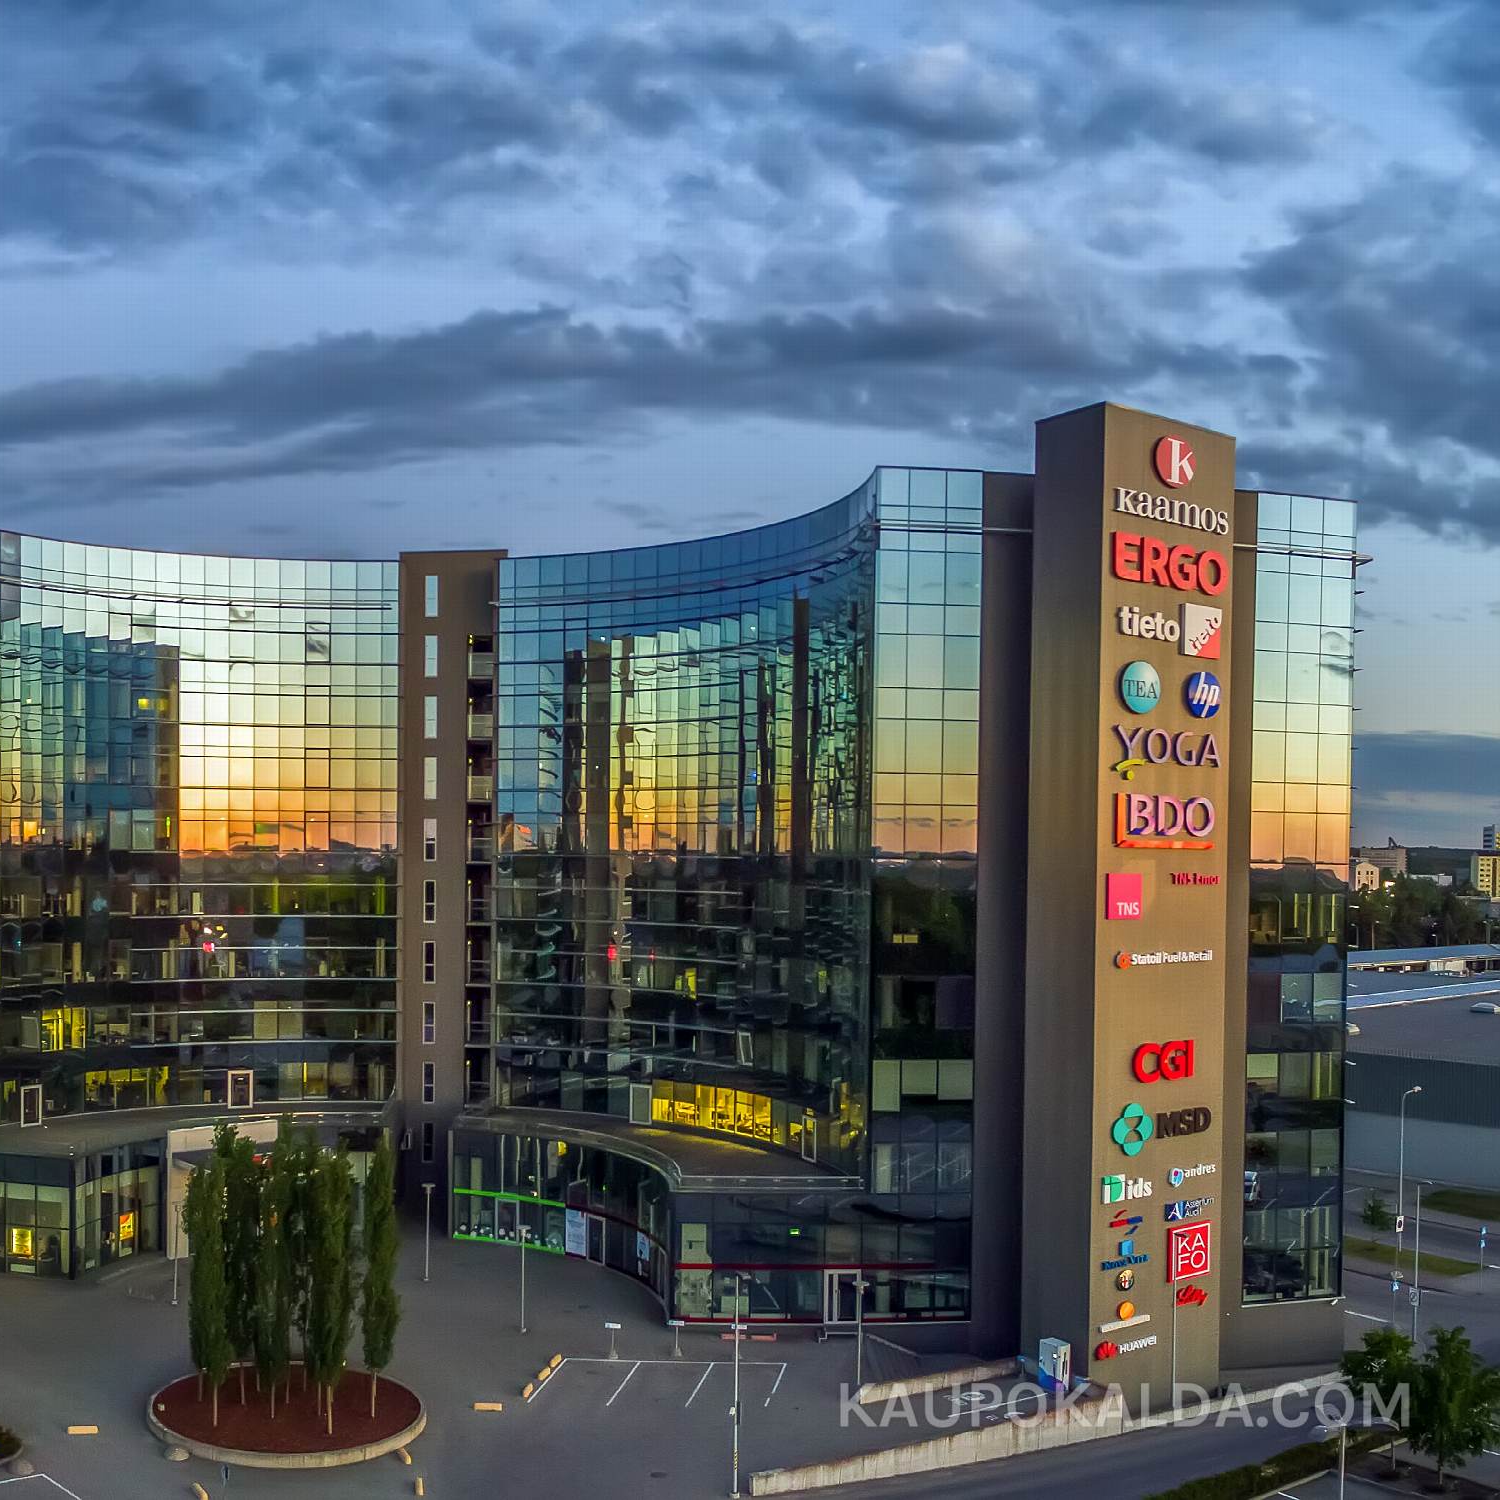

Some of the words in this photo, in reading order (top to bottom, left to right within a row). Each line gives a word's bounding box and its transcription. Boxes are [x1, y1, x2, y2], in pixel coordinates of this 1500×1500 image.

[1113, 531, 1229, 596] ERGO
[1119, 606, 1180, 642] tieto
[1124, 679, 1158, 699] TEA
[1193, 672, 1220, 717] hp
[1115, 724, 1221, 768] YOGA
[1128, 793, 1215, 837] BDO
[1116, 902, 1140, 916] TNS
[1131, 952, 1162, 965] Statoil
[1132, 1040, 1194, 1084] CGI
[1156, 1107, 1211, 1138] MSD
[1184, 1164, 1216, 1178] andres
[1127, 1178, 1153, 1200] ids
[1178, 1233, 1206, 1254] KA
[1178, 1250, 1206, 1272] FO
[1119, 1335, 1157, 1354] HUAWEI
